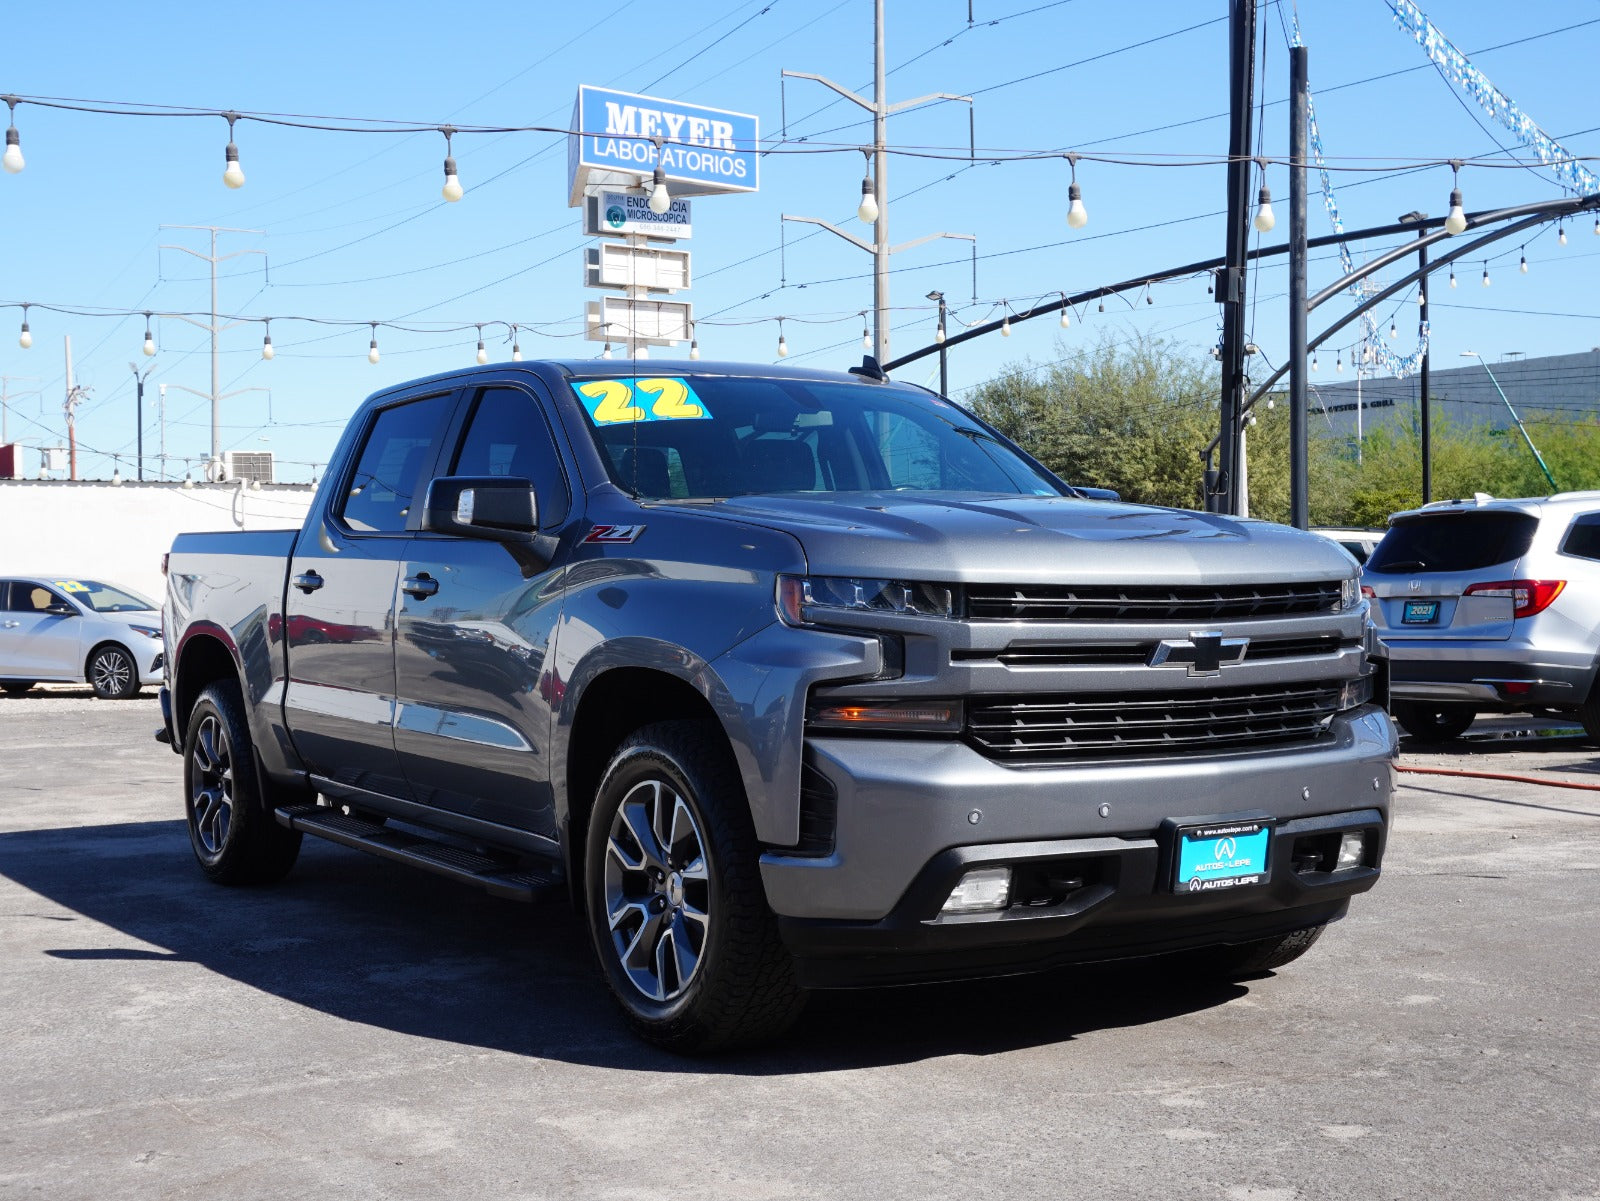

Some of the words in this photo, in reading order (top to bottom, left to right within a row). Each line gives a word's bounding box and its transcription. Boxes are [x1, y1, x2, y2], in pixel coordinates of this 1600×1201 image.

[605, 101, 736, 154] MEYER
[593, 137, 747, 178] LABORATORIOS
[579, 378, 704, 422] 22
[583, 524, 647, 544] Z71
[1410, 605, 1433, 616] 2021
[1203, 825, 1253, 836] www.autoslepe.com
